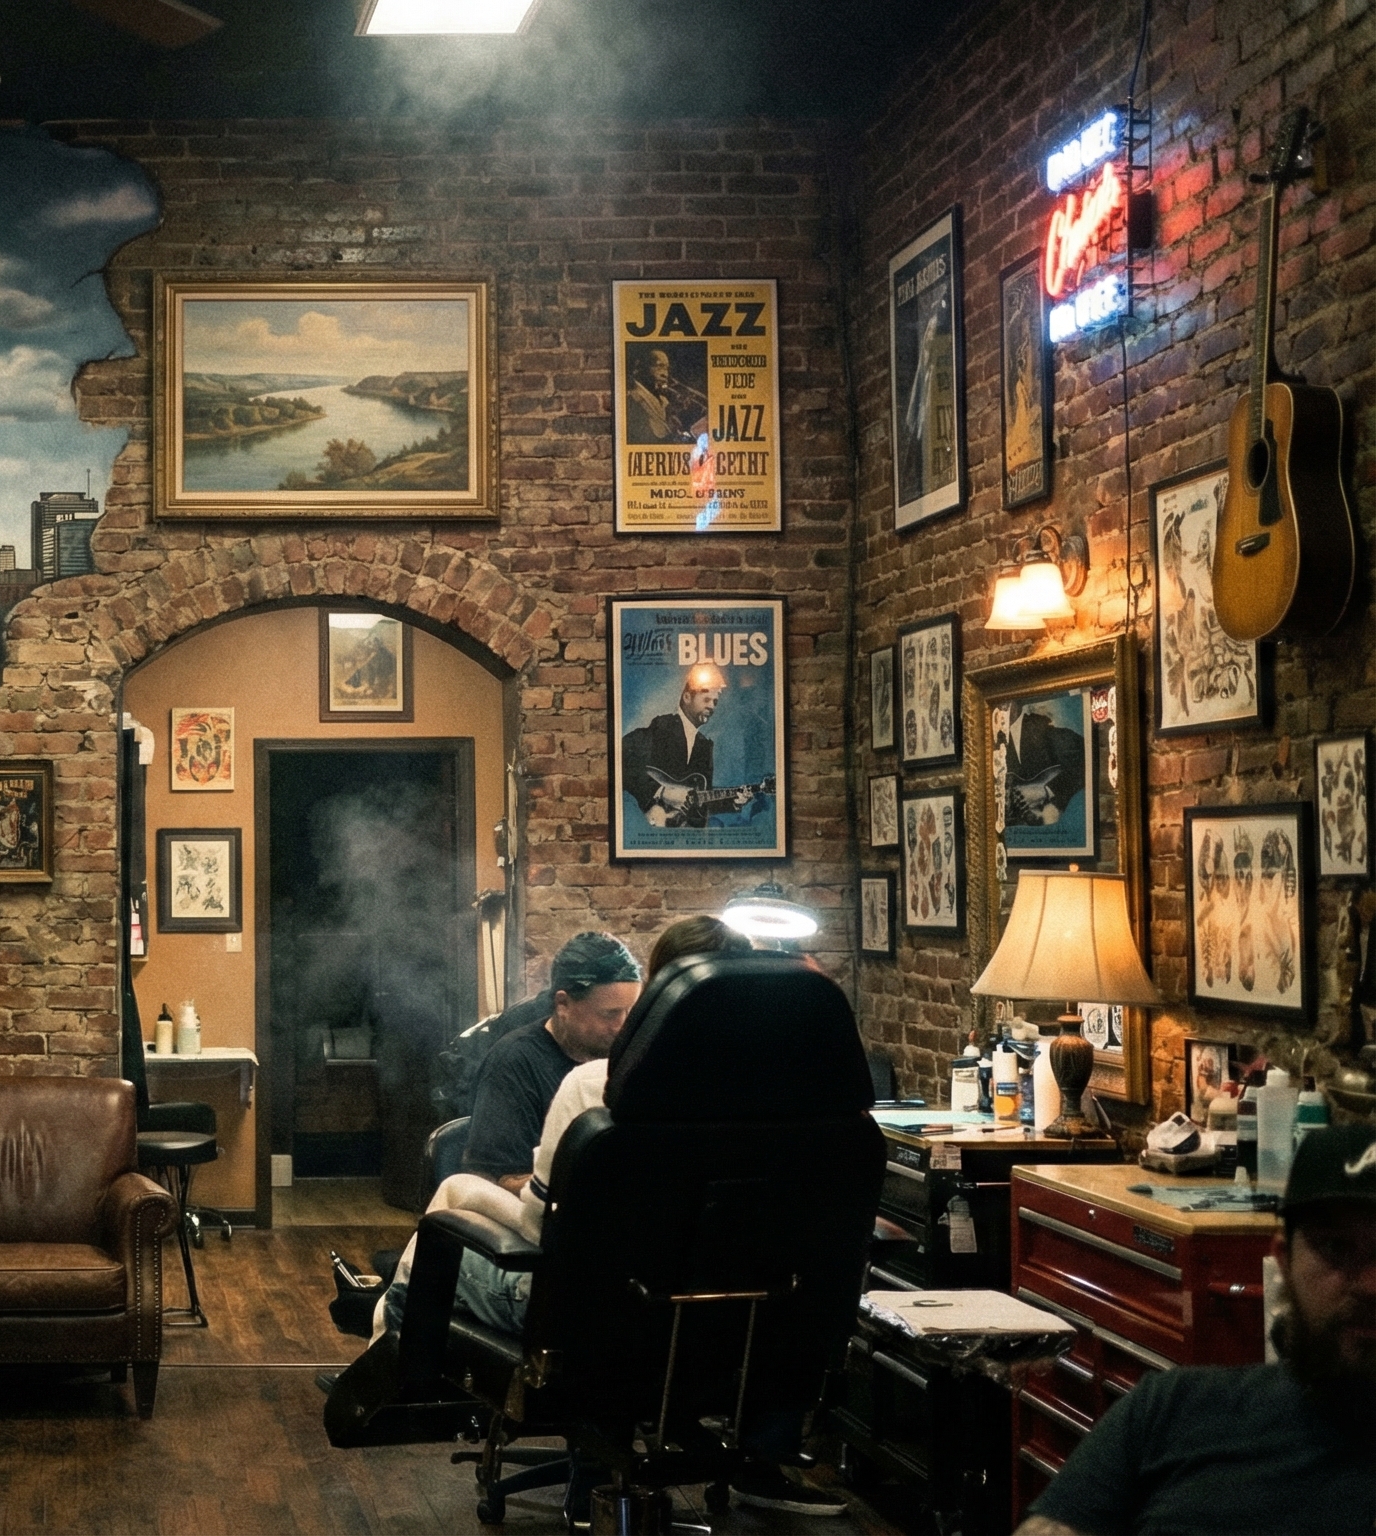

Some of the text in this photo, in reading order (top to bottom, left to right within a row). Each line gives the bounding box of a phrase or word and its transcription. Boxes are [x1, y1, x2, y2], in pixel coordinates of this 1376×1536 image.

[625, 302, 766, 337] JAZZ
[712, 405, 766, 442] JAZZ
[678, 631, 768, 667] BLUES
